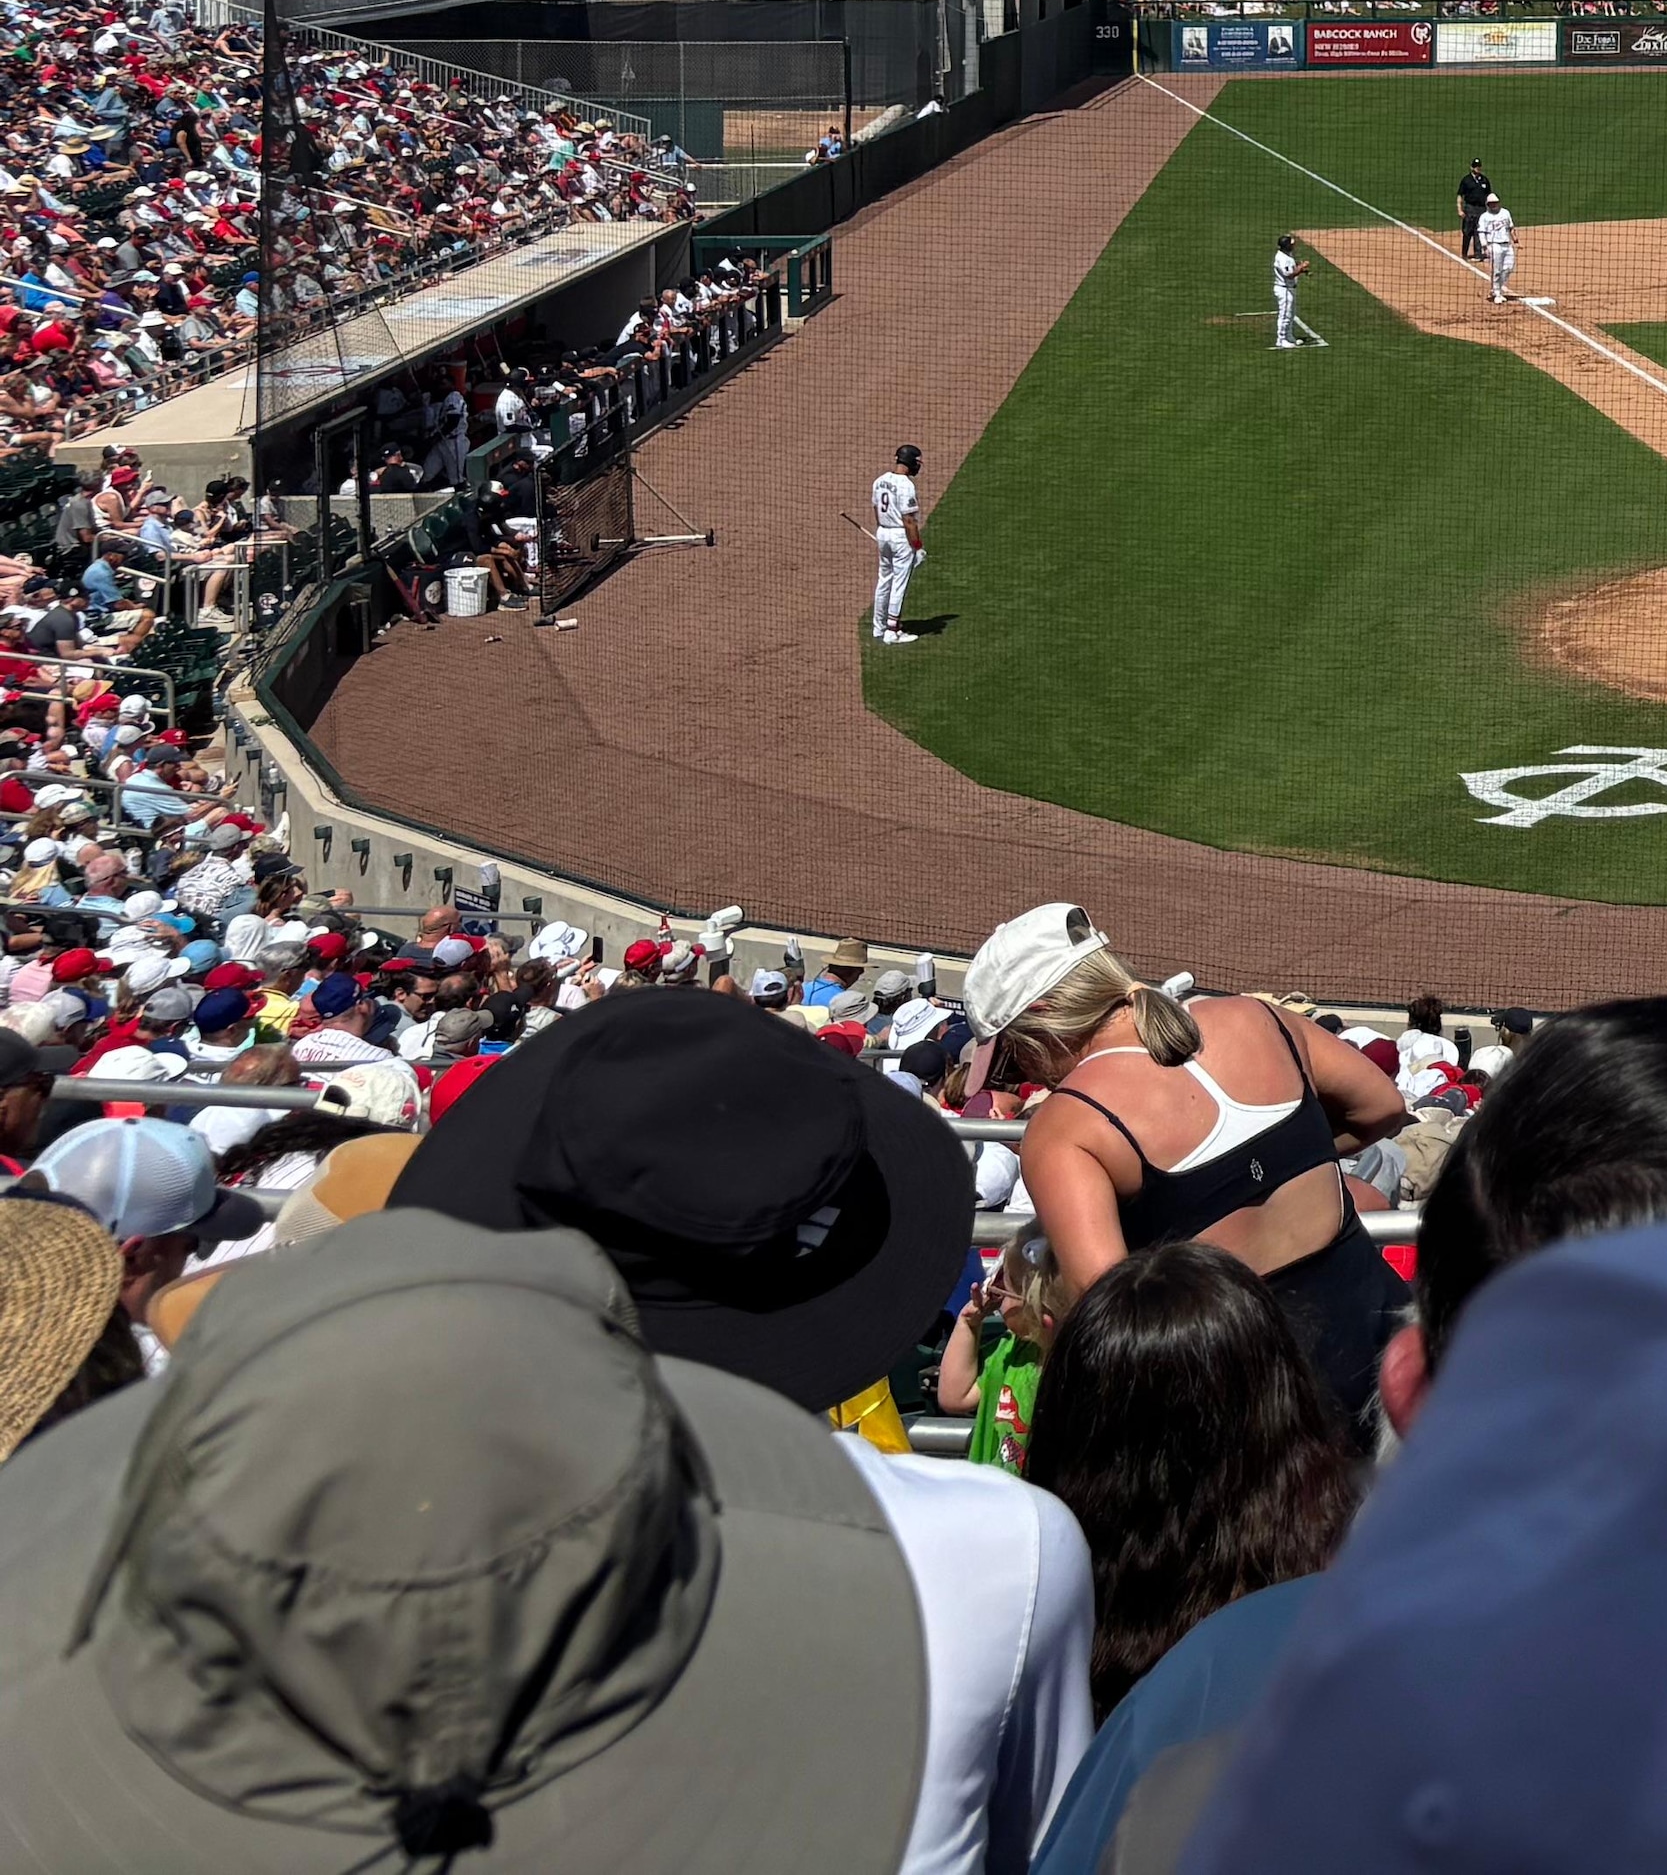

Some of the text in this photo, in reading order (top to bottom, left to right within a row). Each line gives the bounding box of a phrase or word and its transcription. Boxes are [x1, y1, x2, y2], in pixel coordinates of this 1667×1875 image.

[1095, 26, 1120, 38] 330
[1314, 29, 1397, 39] BABCOCK RANCH
[881, 492, 889, 513] 9
